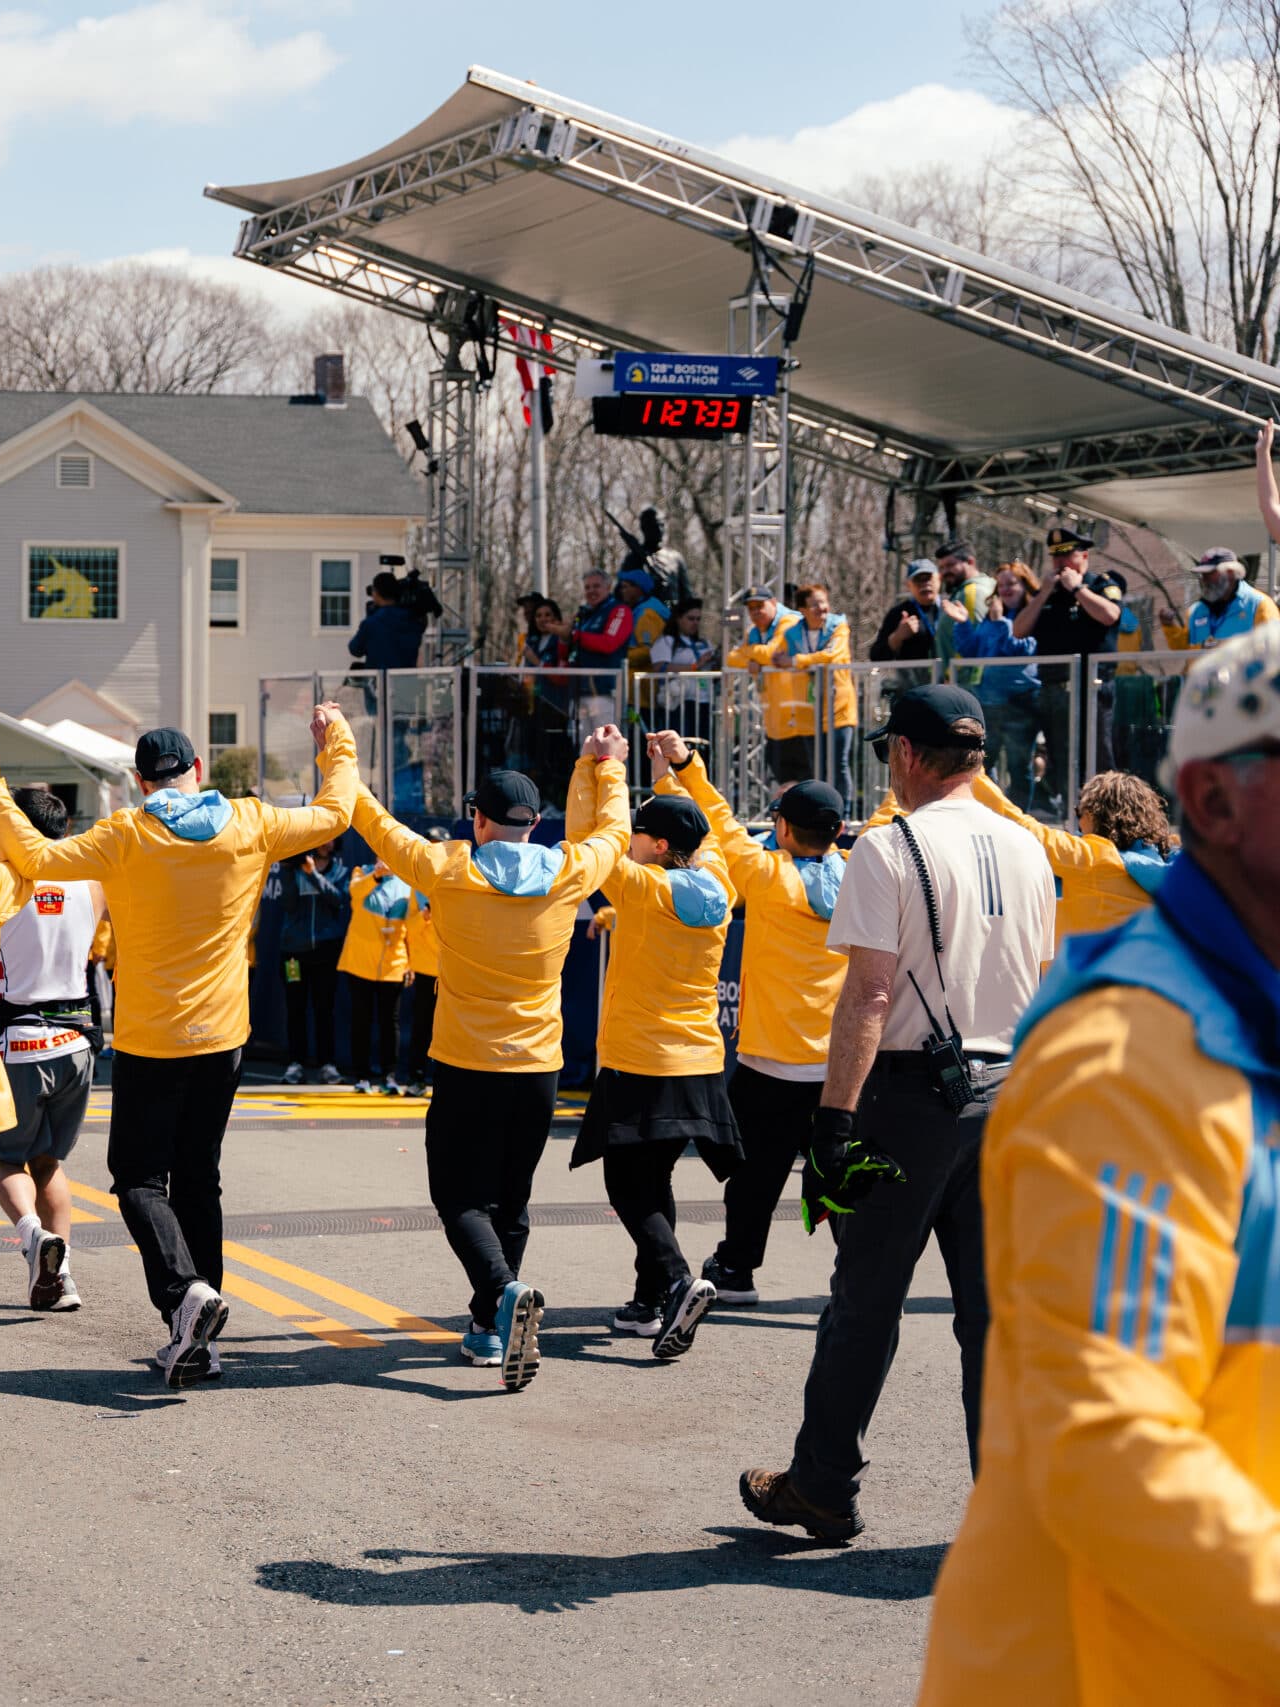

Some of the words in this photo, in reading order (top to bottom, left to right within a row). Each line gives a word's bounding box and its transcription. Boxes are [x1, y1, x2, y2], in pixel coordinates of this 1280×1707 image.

[674, 364, 719, 375] BOSTON
[650, 375, 718, 386] MARATHON
[717, 981, 740, 1002] BO
